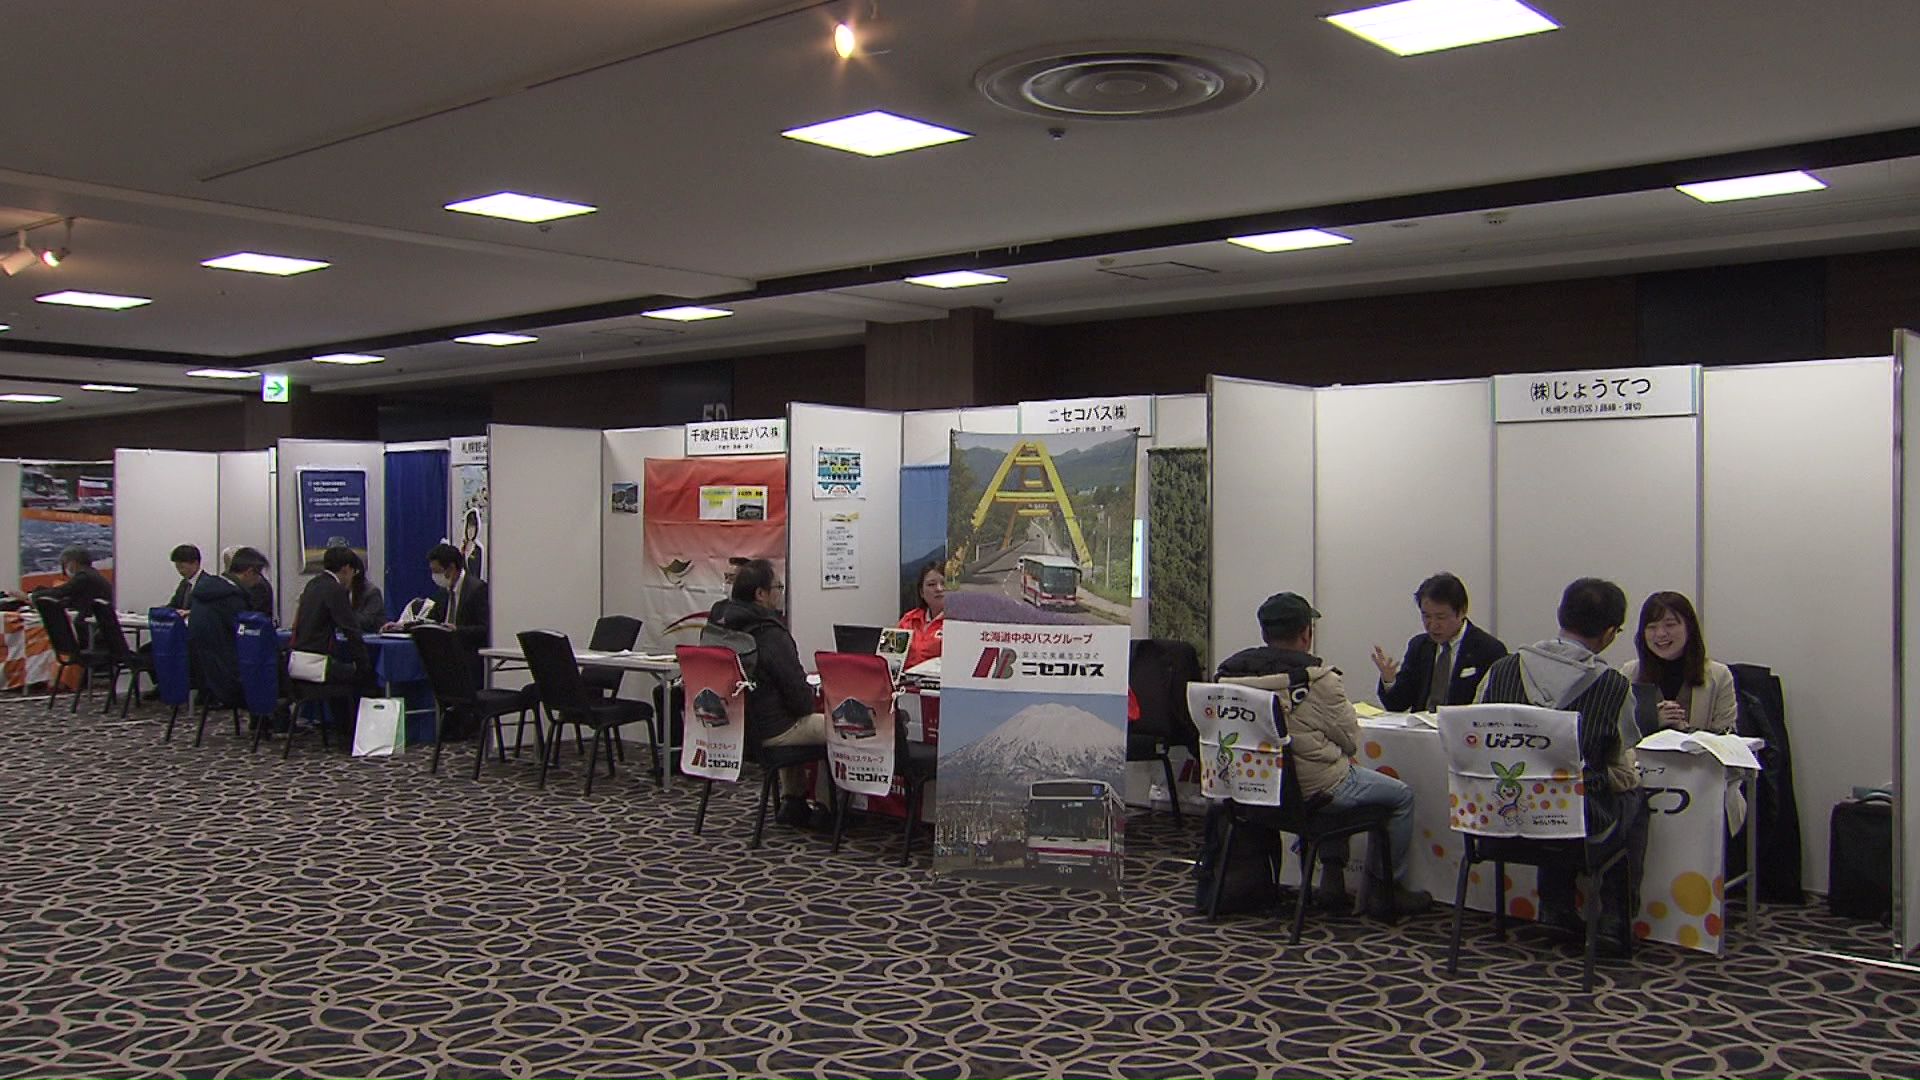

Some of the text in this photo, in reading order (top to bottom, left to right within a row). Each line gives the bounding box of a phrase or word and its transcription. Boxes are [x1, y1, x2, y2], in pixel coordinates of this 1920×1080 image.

[980, 631, 1093, 645] 北海道中央バスグループ
[1022, 662, 1105, 677] ニセコバス
[1485, 733, 1551, 750] じょうてつ
